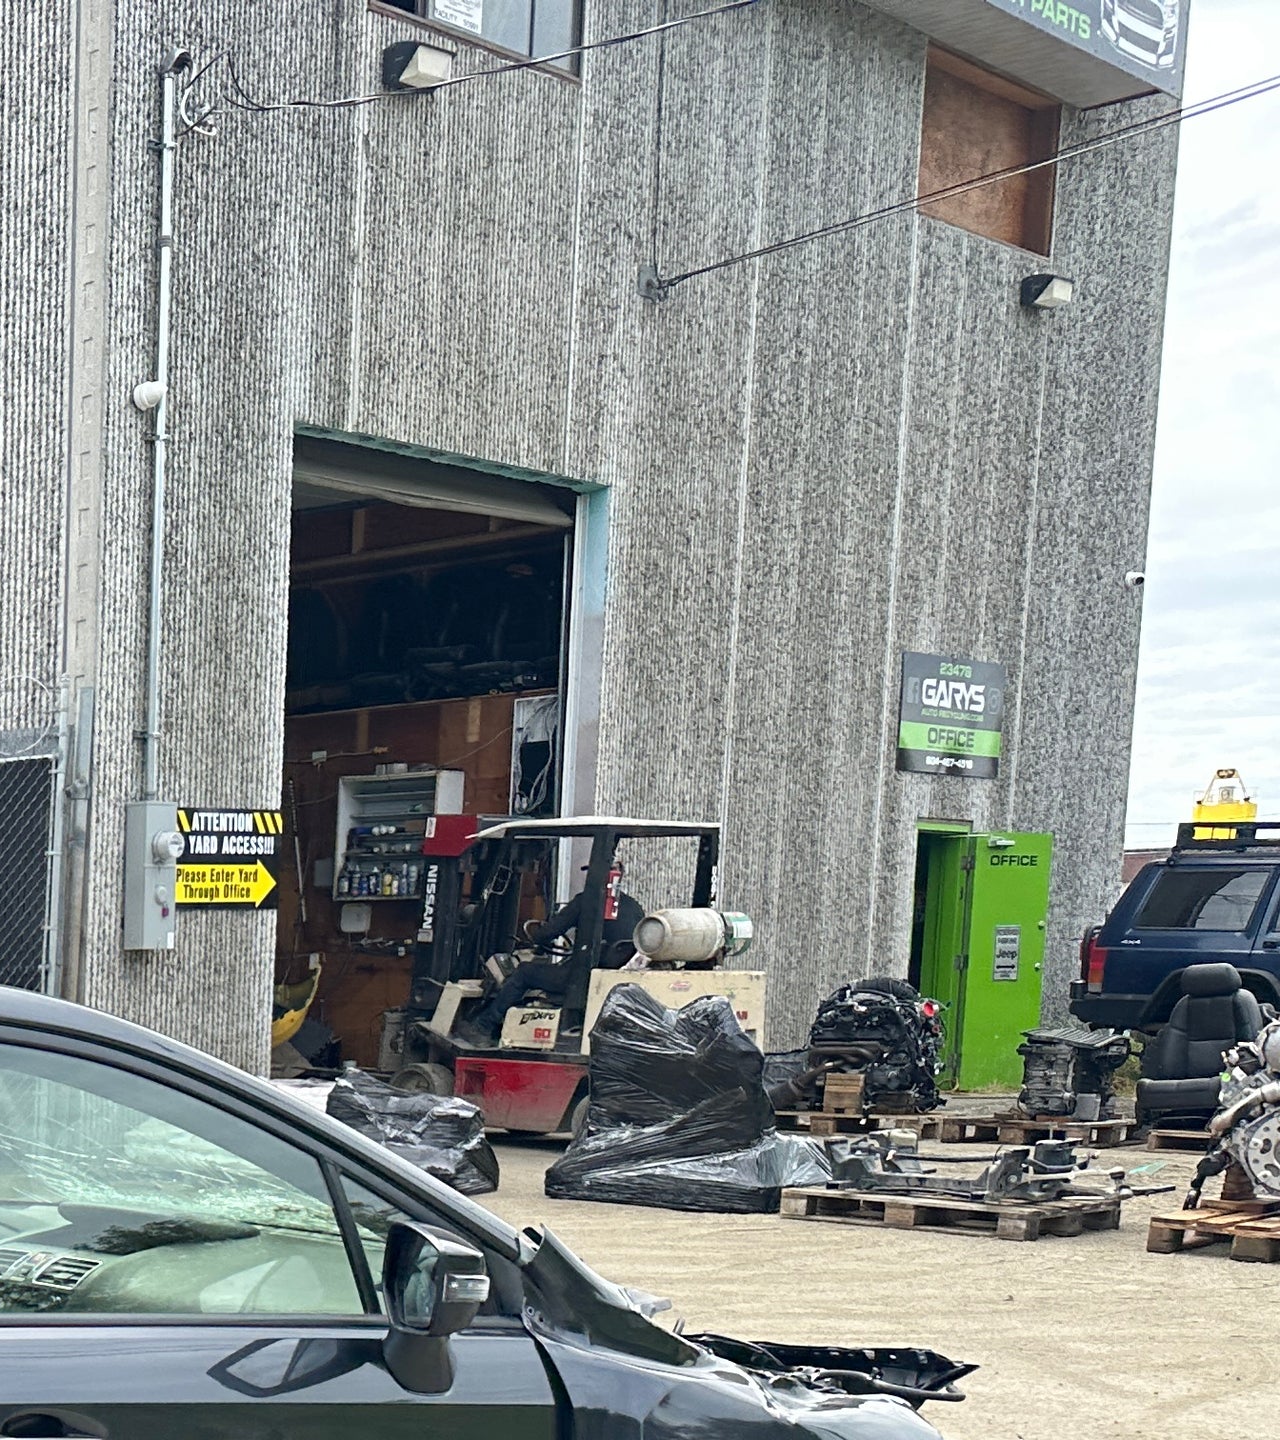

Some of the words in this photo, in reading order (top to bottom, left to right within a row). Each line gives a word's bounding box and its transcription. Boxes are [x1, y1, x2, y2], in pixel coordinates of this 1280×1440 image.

[922, 678, 985, 712] GARYS
[927, 727, 975, 748] OFFICE
[191, 811, 253, 832] ATTENTION
[188, 836, 218, 854] YARD
[221, 836, 275, 854] ACCESS!!!
[990, 855, 1038, 866] OFFICE
[176, 868, 207, 882] Please
[210, 868, 235, 882] Enter
[239, 868, 258, 882] Yard
[183, 885, 220, 901] Through
[223, 885, 251, 898] Office
[422, 864, 438, 929] NISSAN
